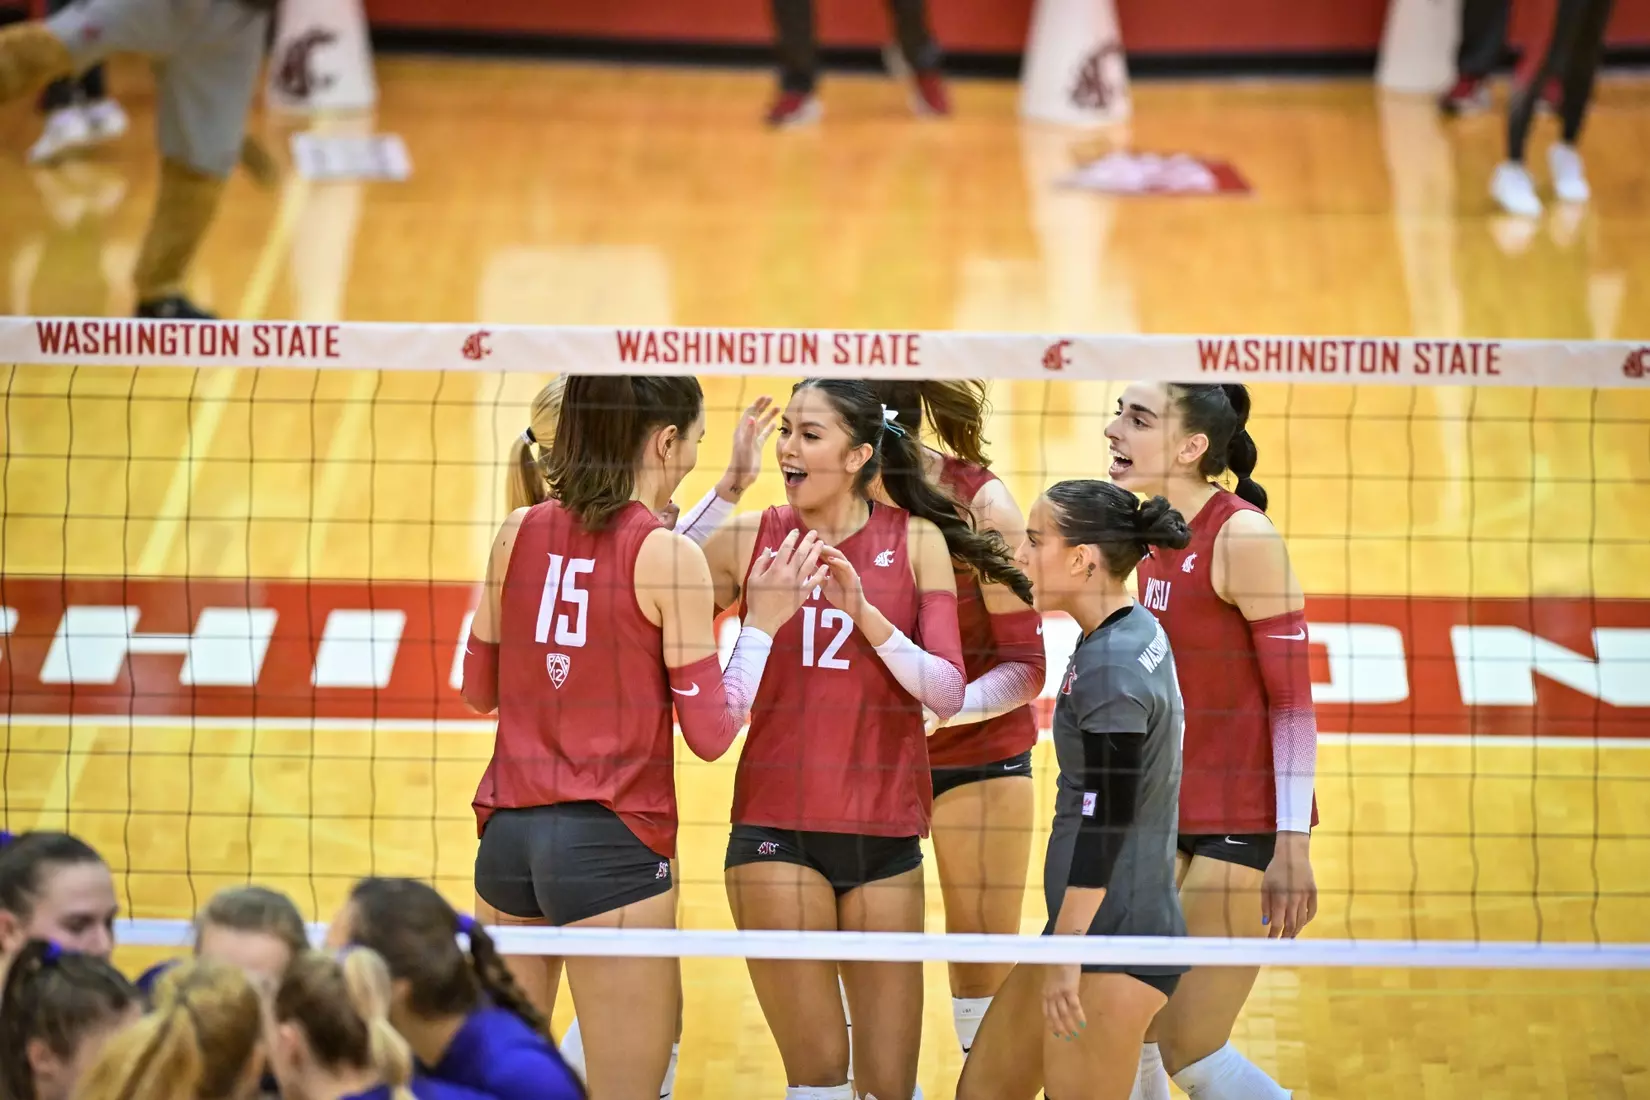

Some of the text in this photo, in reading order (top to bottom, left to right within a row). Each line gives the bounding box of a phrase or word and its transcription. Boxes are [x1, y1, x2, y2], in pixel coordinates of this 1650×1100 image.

[36, 321, 340, 358] WASHINGTON STATE
[616, 330, 921, 366] WASHINGTON STATE
[1197, 339, 1502, 376] WASHINGTON STATE
[535, 552, 596, 648] 15
[1144, 577, 1172, 612] WSU
[802, 606, 854, 670] 12
[552, 668, 564, 682] 12
